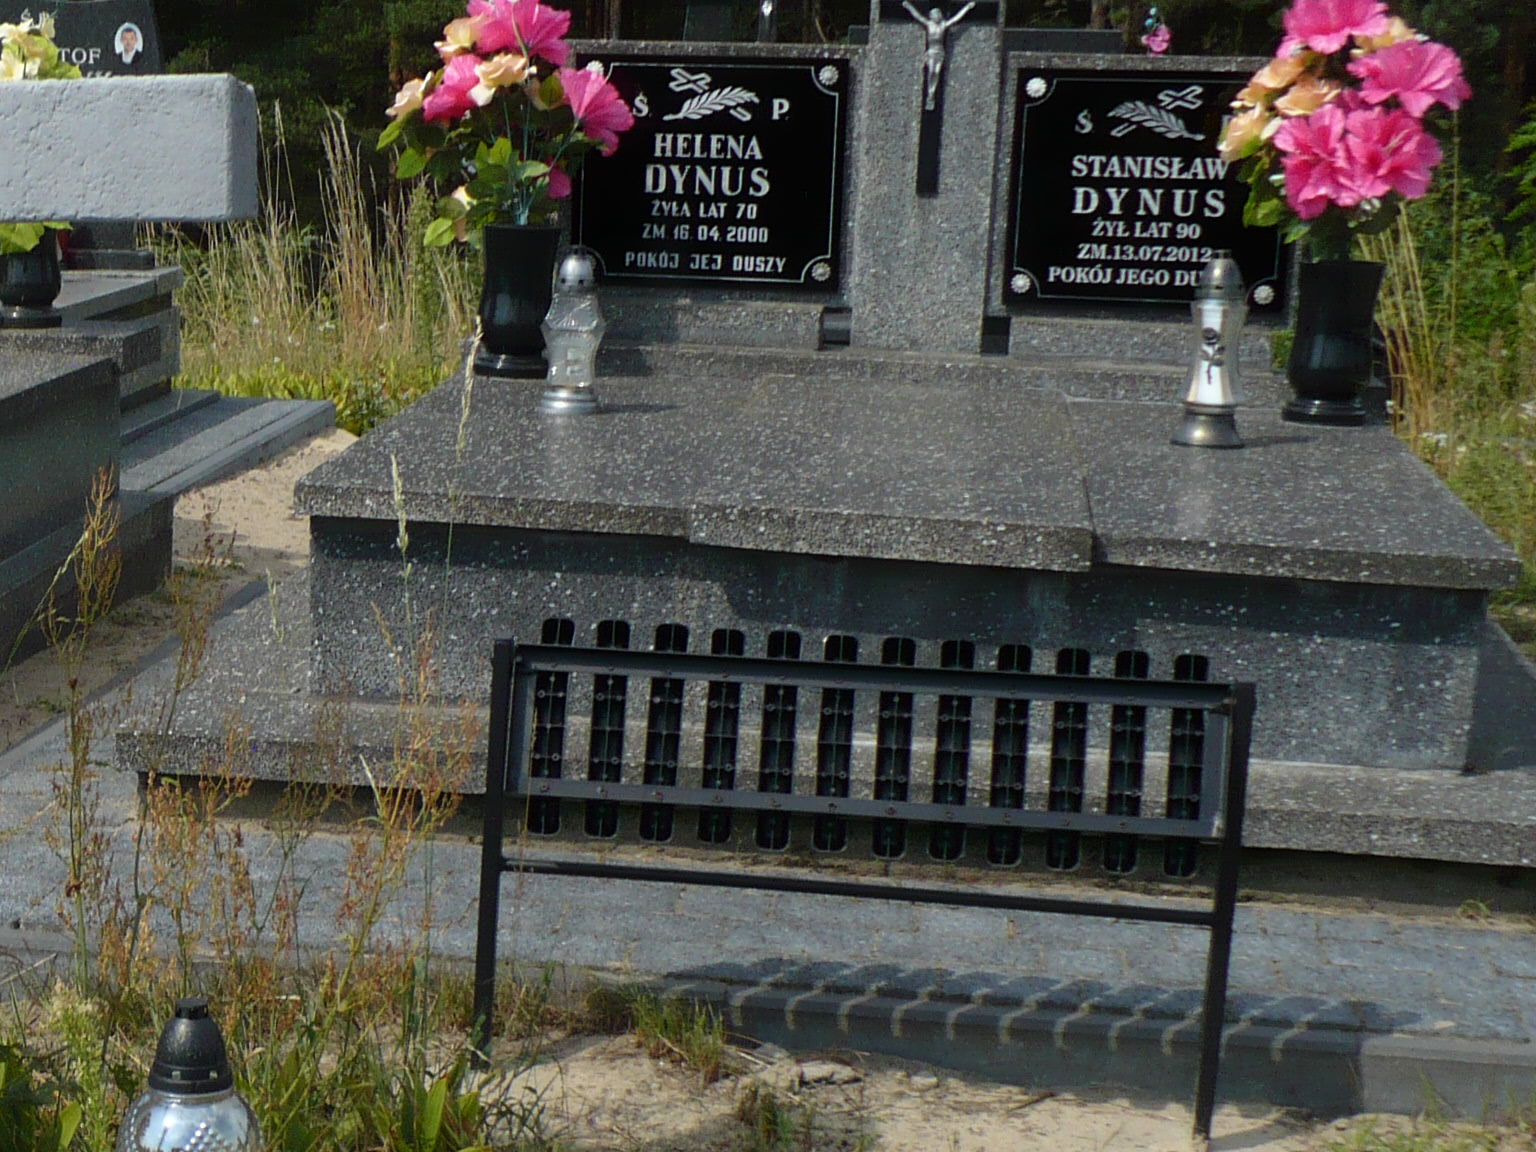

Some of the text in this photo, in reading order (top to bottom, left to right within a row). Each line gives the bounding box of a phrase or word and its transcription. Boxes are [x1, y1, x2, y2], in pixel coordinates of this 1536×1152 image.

[654, 133, 763, 160] HELENA
[1071, 155, 1230, 180] STANISŁAW
[644, 165, 770, 197] DYNUS
[698, 202, 728, 219] LAT
[735, 203, 758, 220] 70
[1071, 187, 1226, 217] DYNUS
[726, 226, 769, 244] 2000
[1091, 216, 1201, 240] ŻYŁ LAT 90
[625, 250, 786, 273] POKÓJ JEJ DUSZY
[1048, 263, 1111, 284] POKÓJ
[1115, 267, 1169, 286] JEGO
